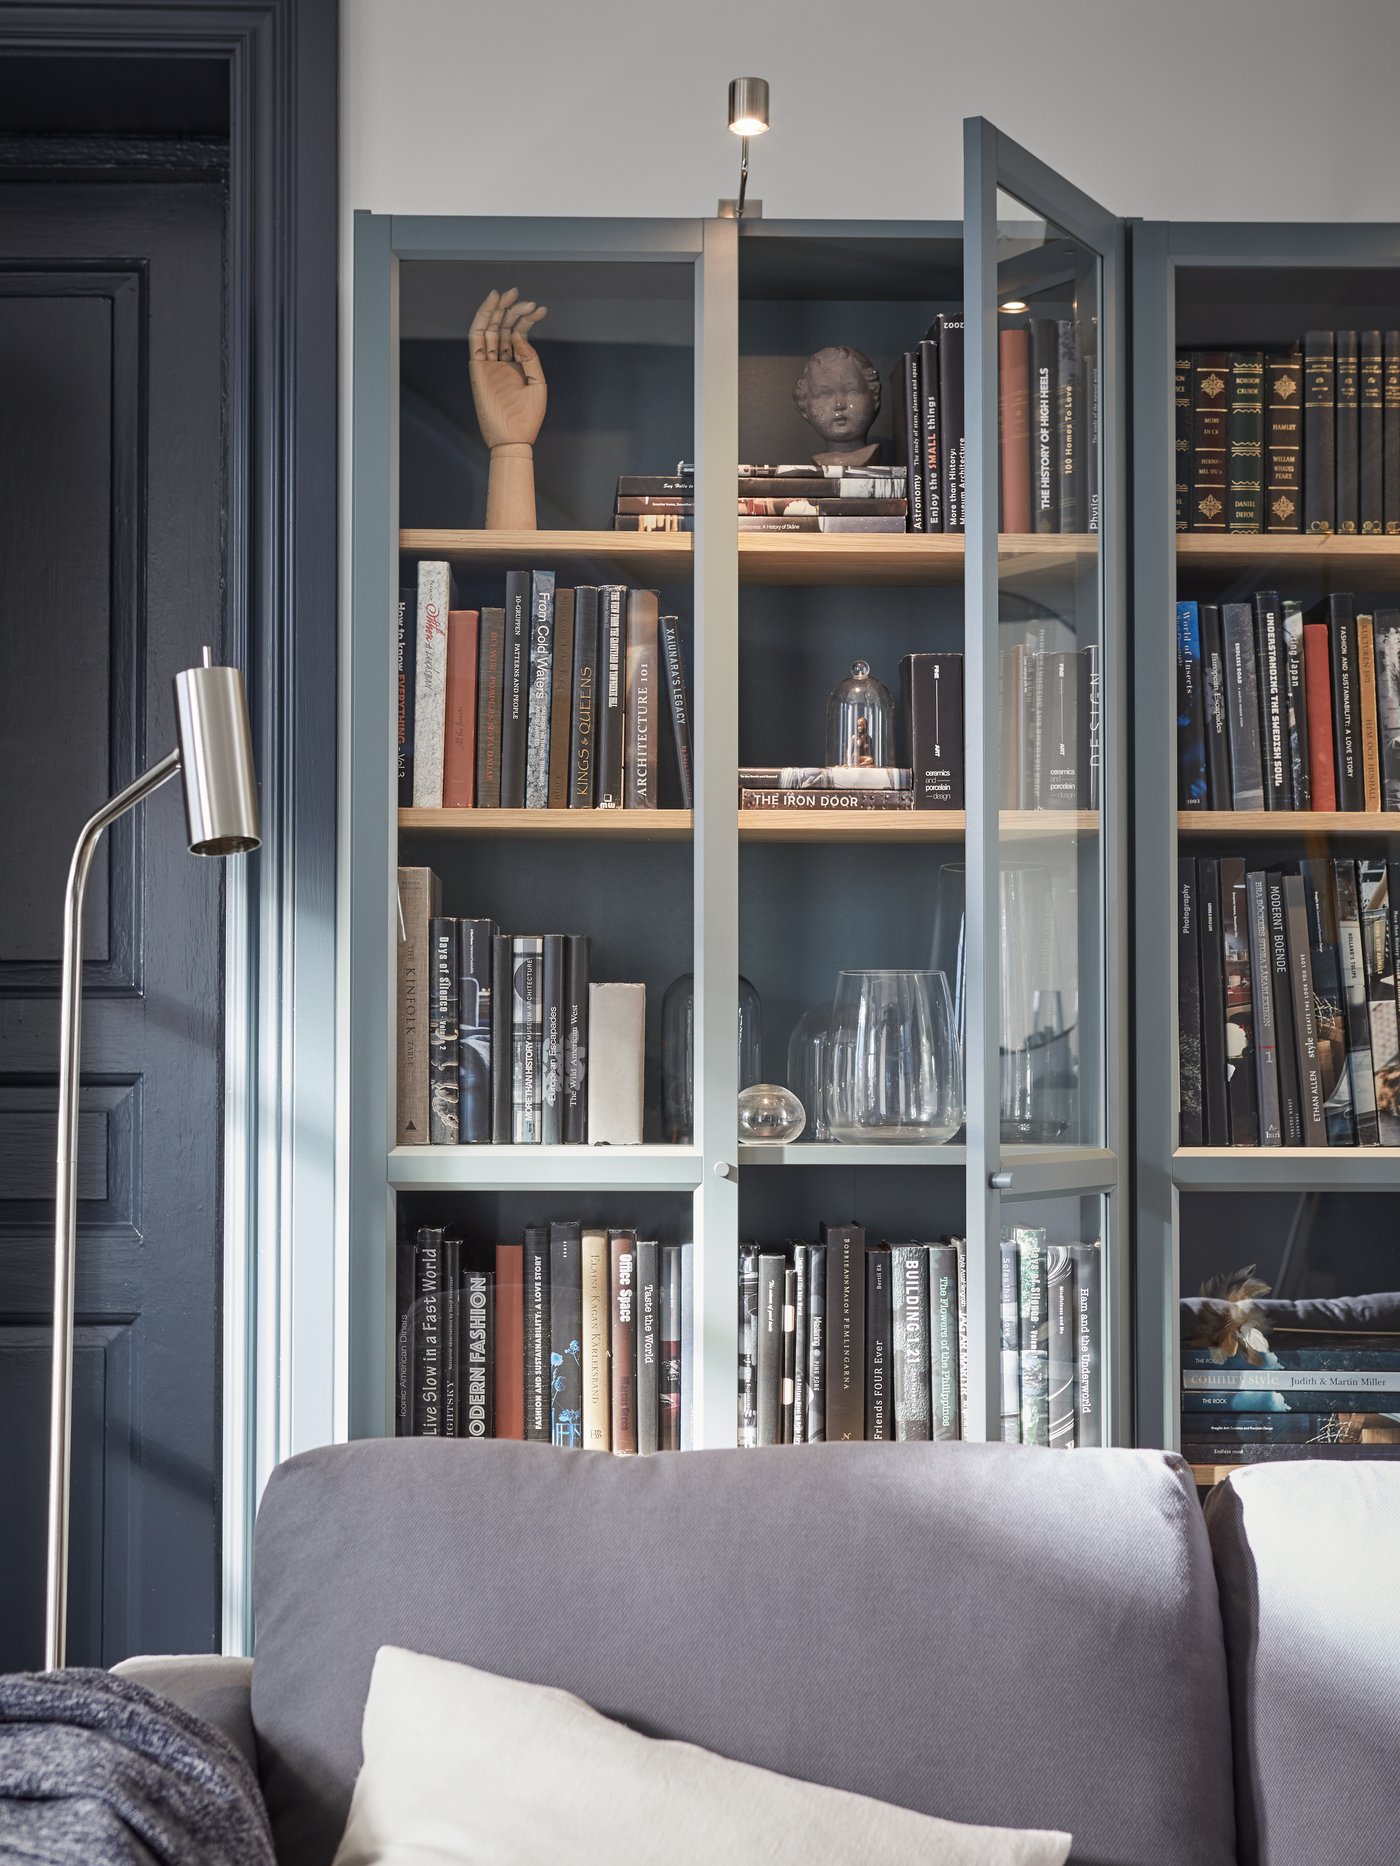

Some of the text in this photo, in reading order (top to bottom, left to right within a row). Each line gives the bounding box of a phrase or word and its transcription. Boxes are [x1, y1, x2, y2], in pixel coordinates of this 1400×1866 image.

[1066, 410, 1072, 420] To
[1040, 368, 1050, 508] THE HISTORY OF HIGH HEELS
[926, 396, 940, 524] Enjoy the SMALL things
[536, 592, 550, 698] From Cold Waters
[1182, 611, 1194, 694] World of Insects
[1340, 626, 1348, 654] FASHION
[1210, 653, 1223, 734] European Escapades
[1266, 612, 1283, 786] UNDERSTANDING THE SWEDISH SOUL
[1342, 673, 1350, 727] SUSTAINABILITY:
[576, 666, 592, 796] KINGS & QUEENS
[636, 663, 648, 796] ARCHITECTURE 101
[754, 794, 858, 807] THE IRON DOOR
[926, 784, 950, 792] porcelain
[933, 792, 951, 801] design
[1050, 783, 1076, 791] porcelain
[1181, 884, 1192, 934] Photography
[1270, 886, 1286, 973] MODERNT BOENDE
[1255, 882, 1270, 1027] BRA BÖCKERS STORA LÄKARLEXIKON
[406, 968, 416, 1035] KINFOLK
[548, 1006, 557, 1101] European Escapades
[570, 1026, 578, 1066] American
[1305, 1037, 1316, 1058] style
[1310, 1070, 1318, 1094] ALLEN
[1311, 1096, 1321, 1122] ETHAN
[422, 1248, 437, 1291] World
[620, 1254, 632, 1284] Office
[1002, 1258, 1010, 1282] Sofas
[422, 1296, 436, 1331] Fast
[618, 1289, 632, 1322] Space
[400, 1314, 408, 1342] Diners
[590, 1254, 601, 1404] ELAINE KAGAN KÄRLEKSBAND
[644, 1284, 654, 1364] Taste the World
[812, 1316, 822, 1346] Mastering
[423, 1348, 436, 1362] in
[874, 1340, 883, 1364] Ever
[940, 1276, 950, 1426] The Flowers of the Philippines
[1080, 1288, 1091, 1414] Ham and the Underworld
[422, 1366, 436, 1402] Slow
[620, 1376, 630, 1406] Marcus
[874, 1368, 883, 1396] FOUR
[1191, 1370, 1386, 1388] country style Judith & Martin Miller
[422, 1406, 436, 1436] Live
[874, 1400, 884, 1440] Friends
